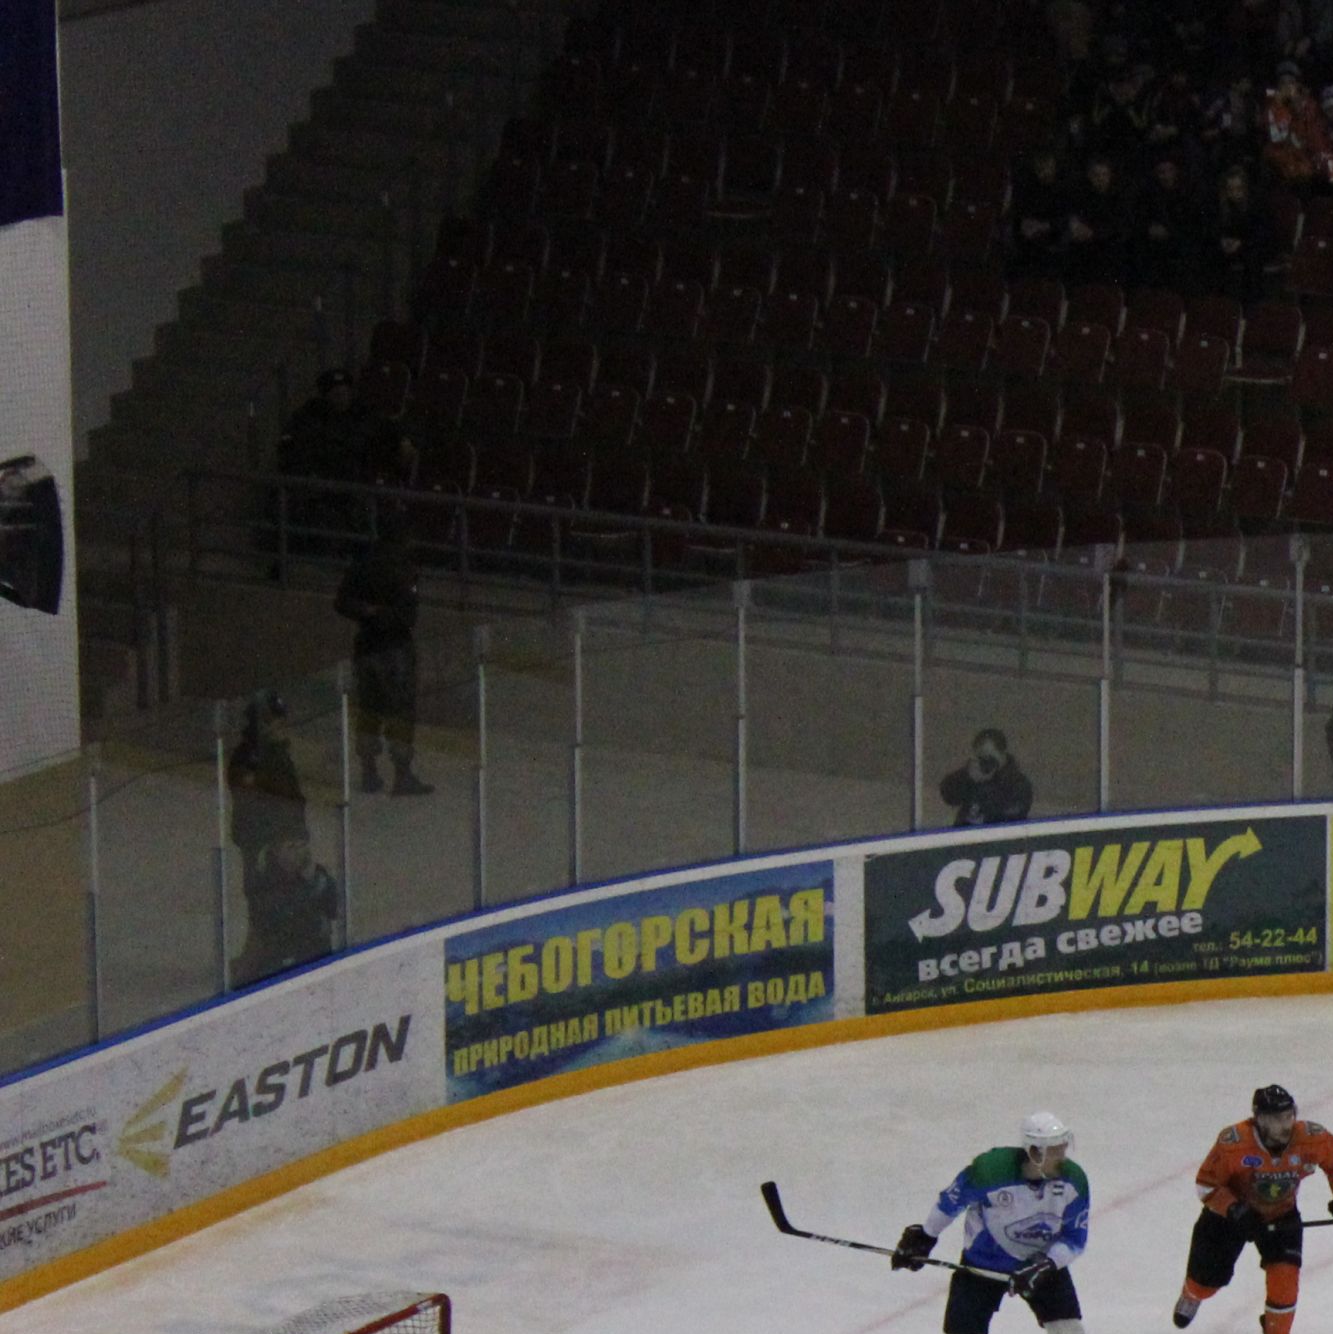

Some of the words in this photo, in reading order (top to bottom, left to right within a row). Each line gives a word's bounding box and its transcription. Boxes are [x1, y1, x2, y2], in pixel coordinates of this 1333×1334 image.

[908, 826, 1262, 943] SUBWAY
[918, 936, 1046, 982] всегда
[1056, 911, 1203, 956] свежее
[1131, 961, 1148, 974] 14
[1229, 927, 1317, 950] 54-22-44
[453, 1012, 598, 1077] ПРИРОДНАЯ
[605, 985, 740, 1033] ПИТЬЕВАЯ
[747, 971, 825, 1009] ВОДА
[174, 1015, 411, 1149] EASTON
[0, 1147, 36, 1197] ES
[40, 1122, 101, 1181] ETC.
